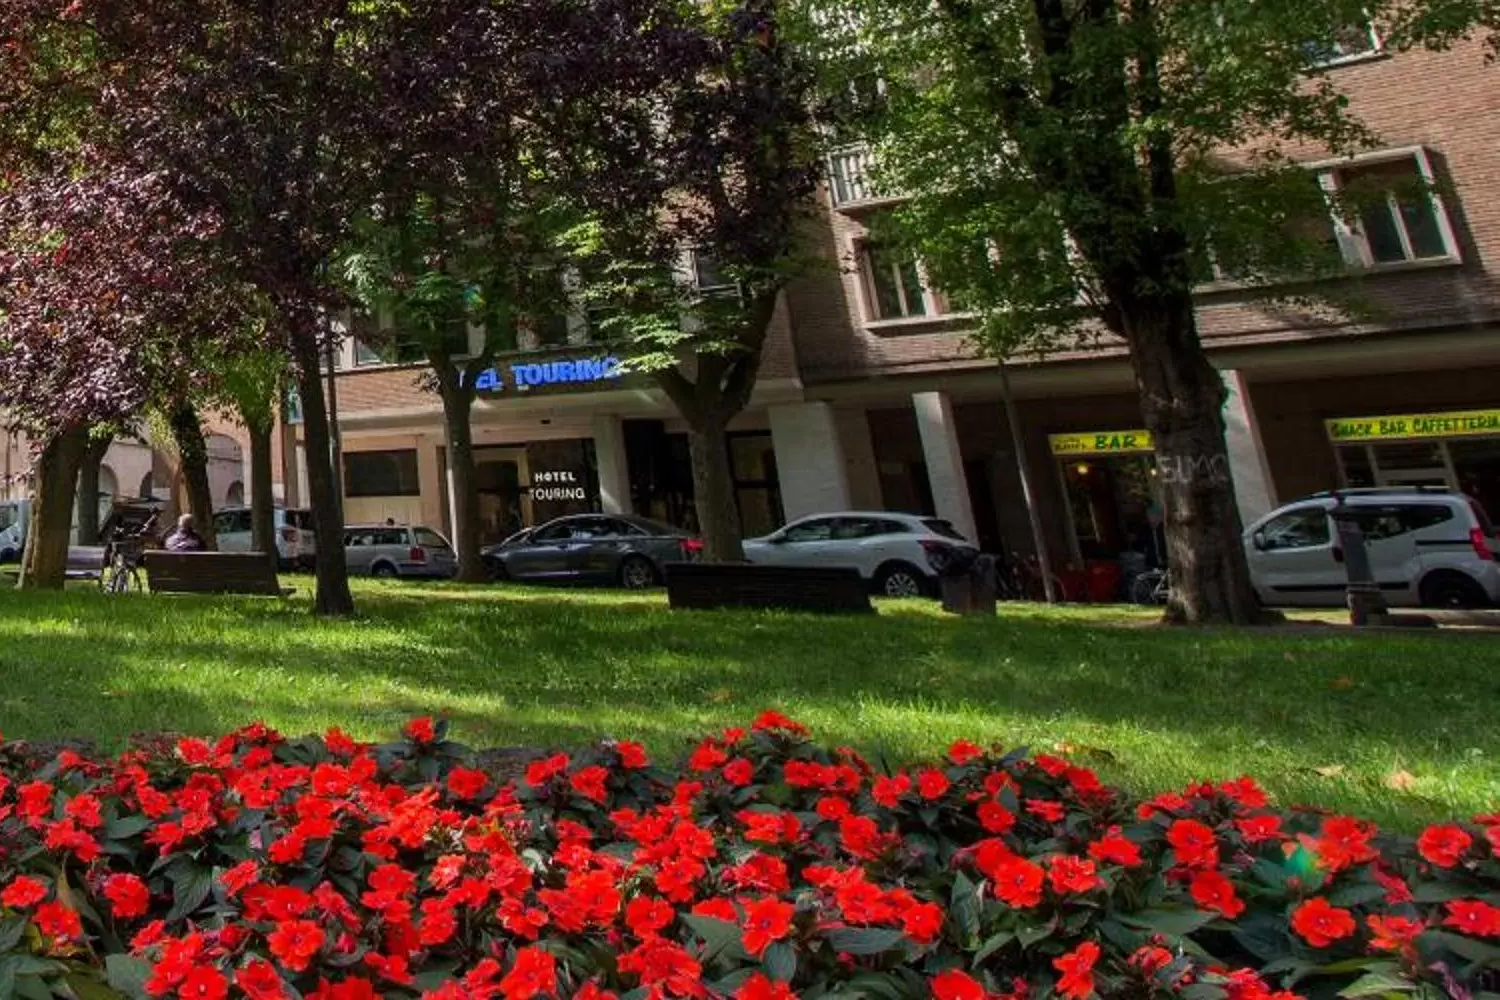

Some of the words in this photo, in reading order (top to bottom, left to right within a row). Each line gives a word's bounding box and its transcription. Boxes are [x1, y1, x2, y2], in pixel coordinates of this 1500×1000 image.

[511, 357, 620, 386] TOURING
[1380, 419, 1408, 435] BAR
[1095, 433, 1135, 450] BAR
[534, 471, 577, 483] HOTEL
[528, 487, 586, 501] TOURING
